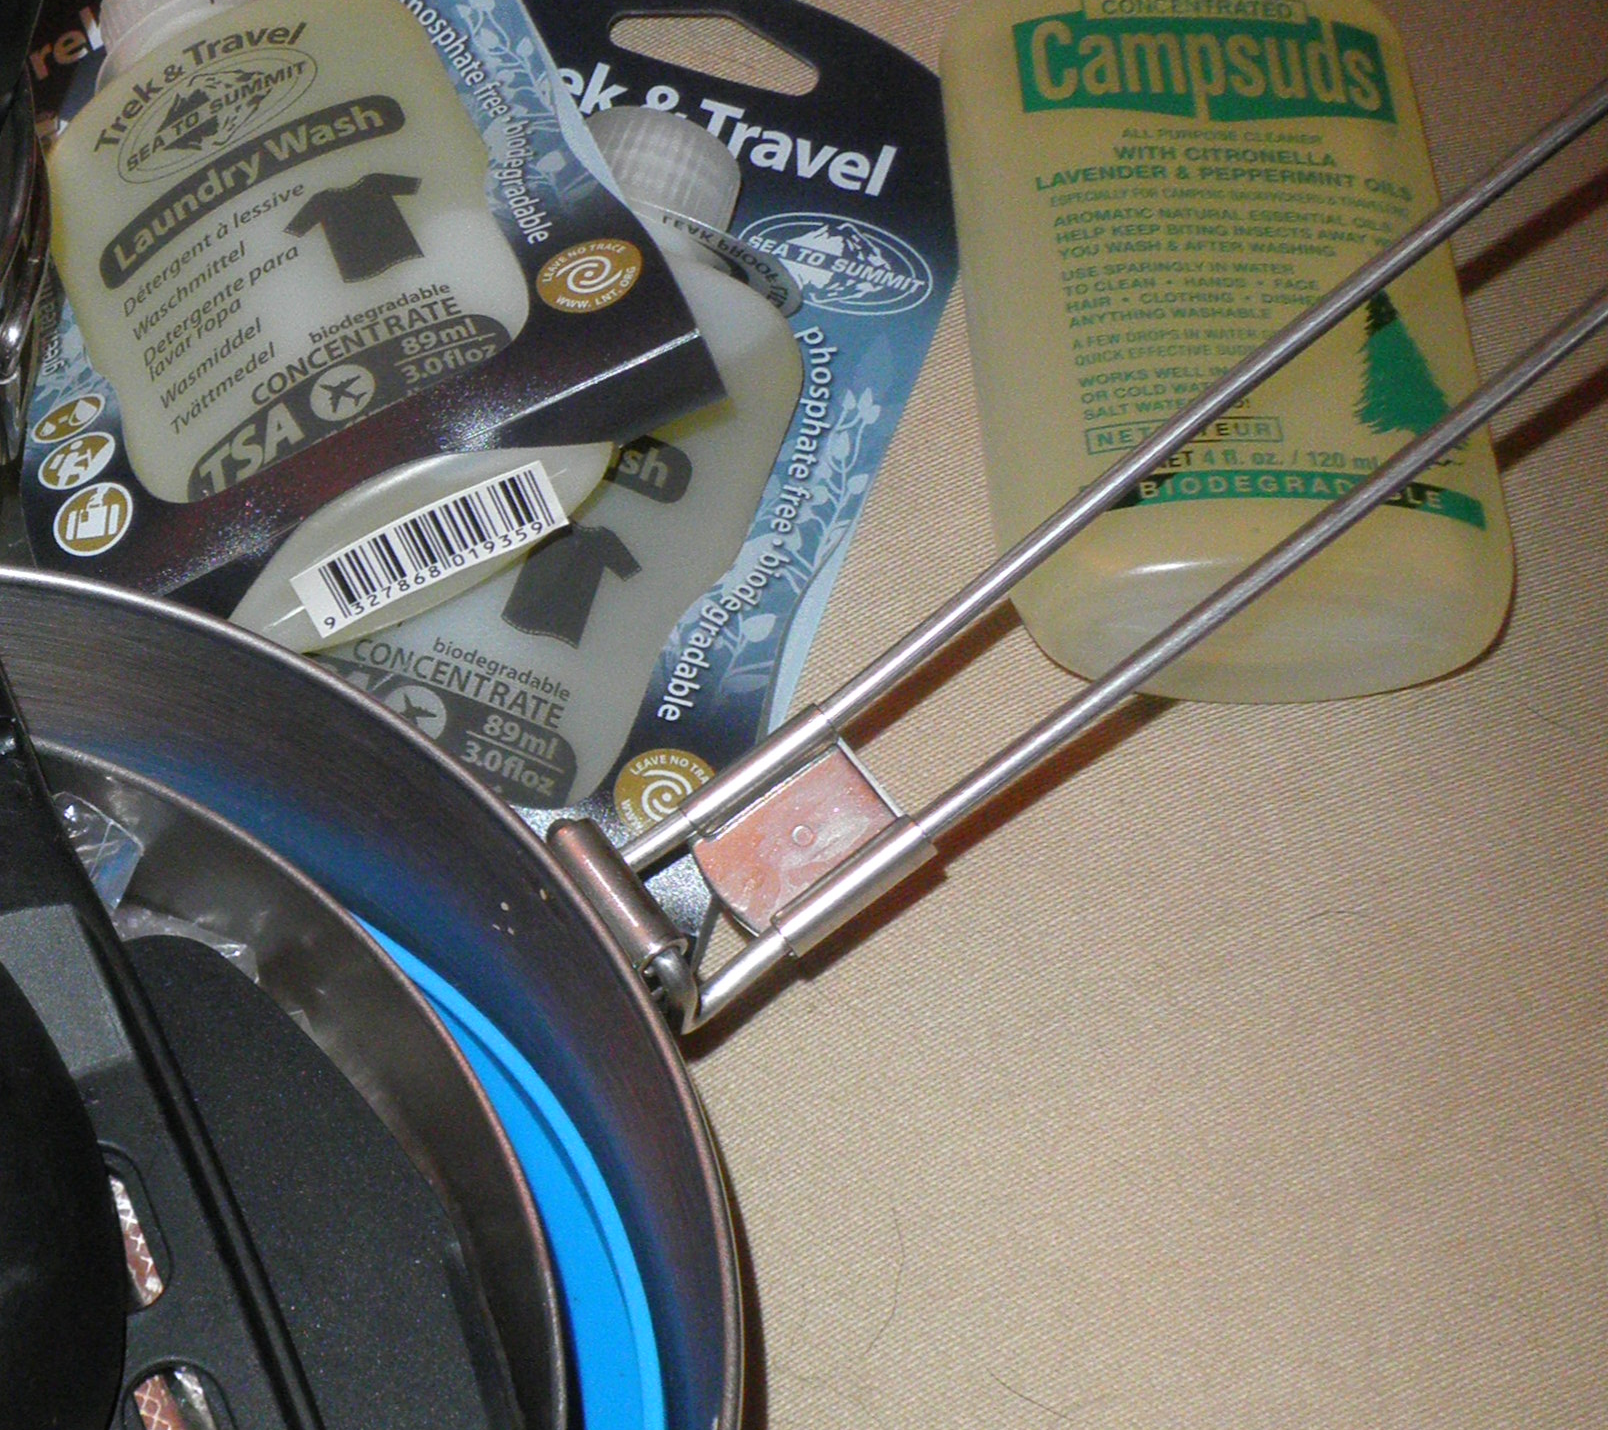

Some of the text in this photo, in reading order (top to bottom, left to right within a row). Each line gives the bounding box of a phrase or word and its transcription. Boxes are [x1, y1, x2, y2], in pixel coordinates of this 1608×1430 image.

[94, 79, 164, 153] Trek
[163, 63, 185, 85] &
[183, 21, 307, 66] Travel
[1031, 19, 1382, 122] Campsuds
[125, 59, 308, 172] SEA TO SUMMIT
[1121, 128, 1155, 140] ALL
[1157, 128, 1238, 141] PURPOSE
[473, 80, 509, 119] free
[495, 120, 550, 245] biodegradable
[697, 97, 898, 197] Travel
[1113, 145, 1336, 167] WITH CITRONELLA
[112, 104, 385, 273] Laundry Wash
[1035, 165, 1169, 191] LAVENDER
[1176, 165, 1190, 180] &
[1199, 166, 1355, 187] PEPPERMINT
[1054, 207, 1154, 227] AROMATIC
[1158, 208, 1240, 222] NATURAL
[1248, 209, 1347, 225] ESSENTIAL
[1056, 227, 1105, 244] HELP
[1111, 224, 1161, 237] KEEP
[1166, 224, 1228, 238] BITING
[1233, 224, 1313, 239] INSECTS
[1317, 228, 1368, 243] AWAY
[122, 182, 305, 318] Détergent à lessive
[542, 242, 627, 284] LEAVE NO TRACE
[746, 233, 926, 293] SEA TO SUMMIT
[1059, 240, 1337, 260] YOU WASH & AFTER WASHING
[1061, 261, 1296, 282] USE SPARINGLY IN WATER
[132, 240, 246, 341] Waschmittel
[143, 244, 300, 368] Detergente para
[1062, 276, 1321, 298] TO CLEAN HANDS FACE
[1065, 292, 1323, 314] HAIR CLOTHING DISHE
[308, 281, 452, 345] biodegradable
[1068, 307, 1271, 329] ANYTHING WASHABLE
[148, 296, 243, 383] lavar ropa
[159, 316, 262, 409] Wasmiddel
[250, 295, 463, 407] CONCENTRATE
[1072, 338, 1084, 351] A
[1087, 333, 1121, 348] FEW
[1125, 329, 1180, 344] DROPS
[1183, 329, 1201, 340] IN
[1205, 329, 1260, 340] WATER
[1074, 348, 1125, 367] QUICK
[1128, 344, 1213, 358] EFFECTIVE
[169, 340, 276, 435] Tvättmedel
[1078, 368, 1149, 388] WORKS
[1155, 367, 1211, 379] WELL
[1081, 390, 1110, 405] OR
[1113, 383, 1167, 399] COLD
[1083, 402, 1130, 421] SALT
[199, 401, 306, 495] TSA
[1203, 451, 1217, 466] 4
[1222, 448, 1246, 465] fl.
[1251, 451, 1284, 466] oz.
[1306, 451, 1346, 468] 120
[1140, 473, 1443, 509] BIODEGRADLE
[655, 325, 840, 723] phosphate free biodegradable
[352, 638, 566, 730] CONCENTRATE
[432, 635, 572, 703] biodegradable
[629, 754, 668, 776] LEAVE
[668, 754, 690, 768] NO
